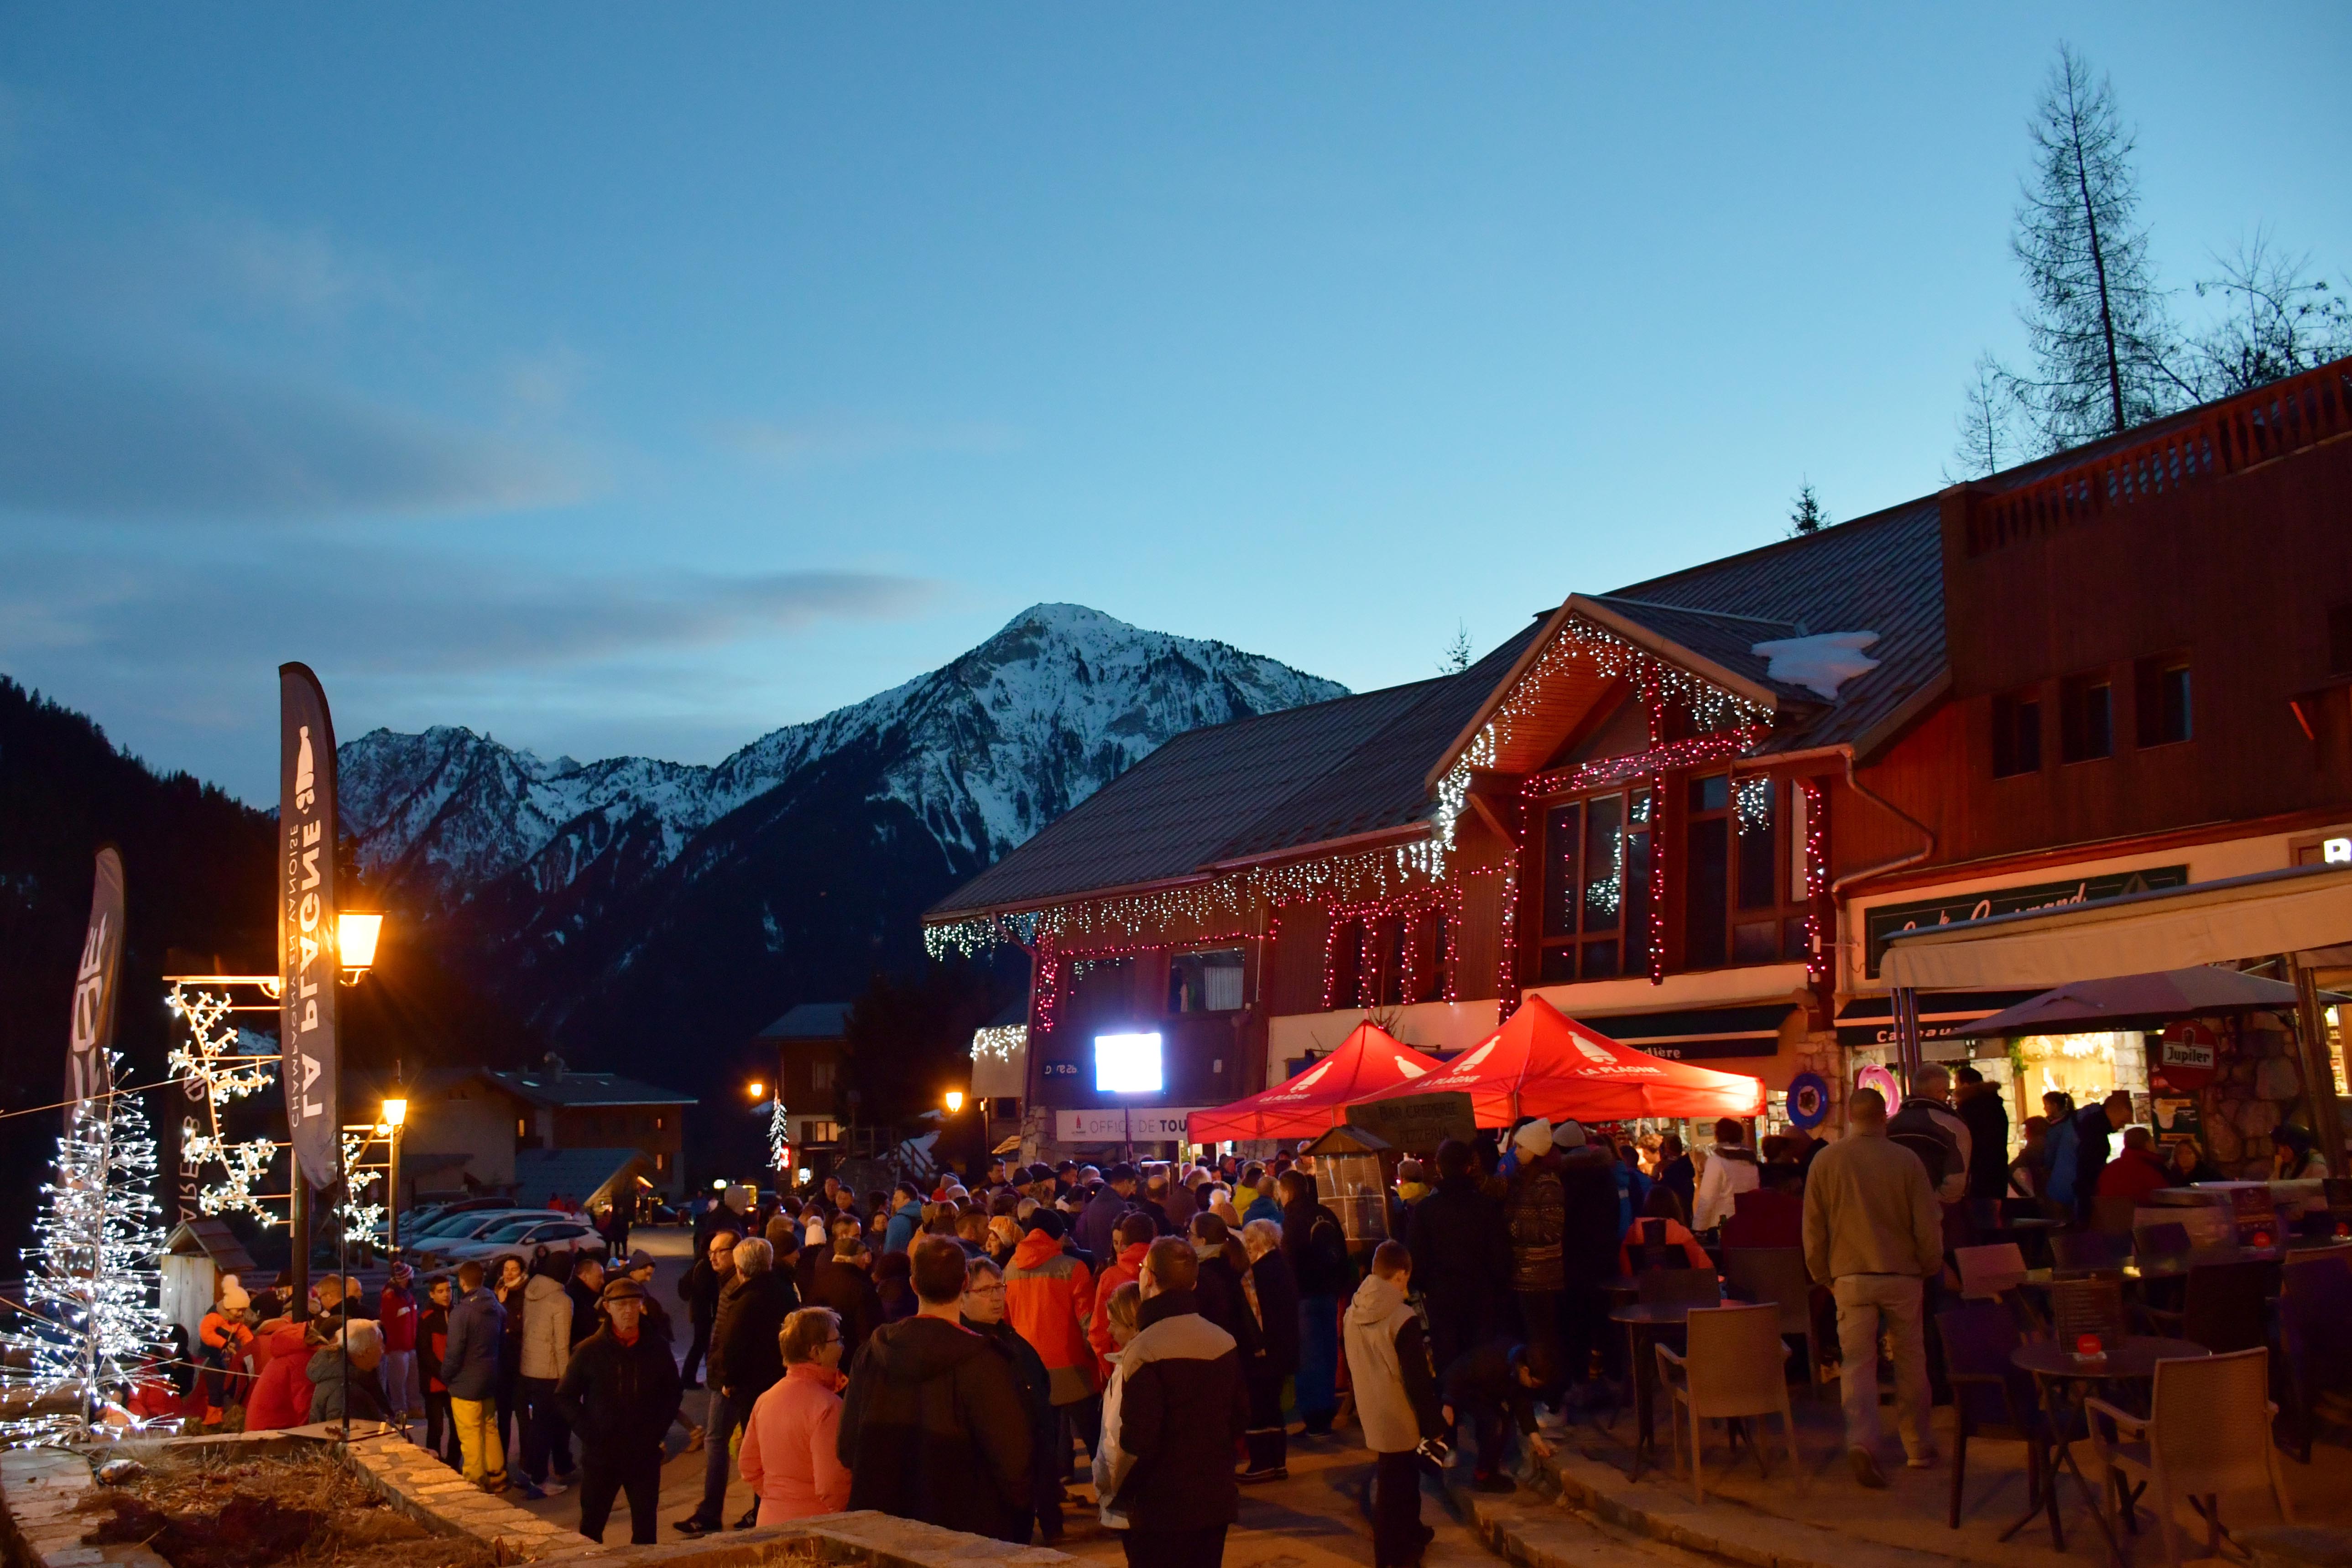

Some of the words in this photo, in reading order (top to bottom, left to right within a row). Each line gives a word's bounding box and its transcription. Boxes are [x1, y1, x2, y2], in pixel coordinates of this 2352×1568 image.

[2167, 1047, 2210, 1063] Jupiler
[1431, 1075, 1481, 1085] PLAGNE
[1378, 1105, 1402, 1120] BAR
[1139, 1120, 1155, 1133] DE
